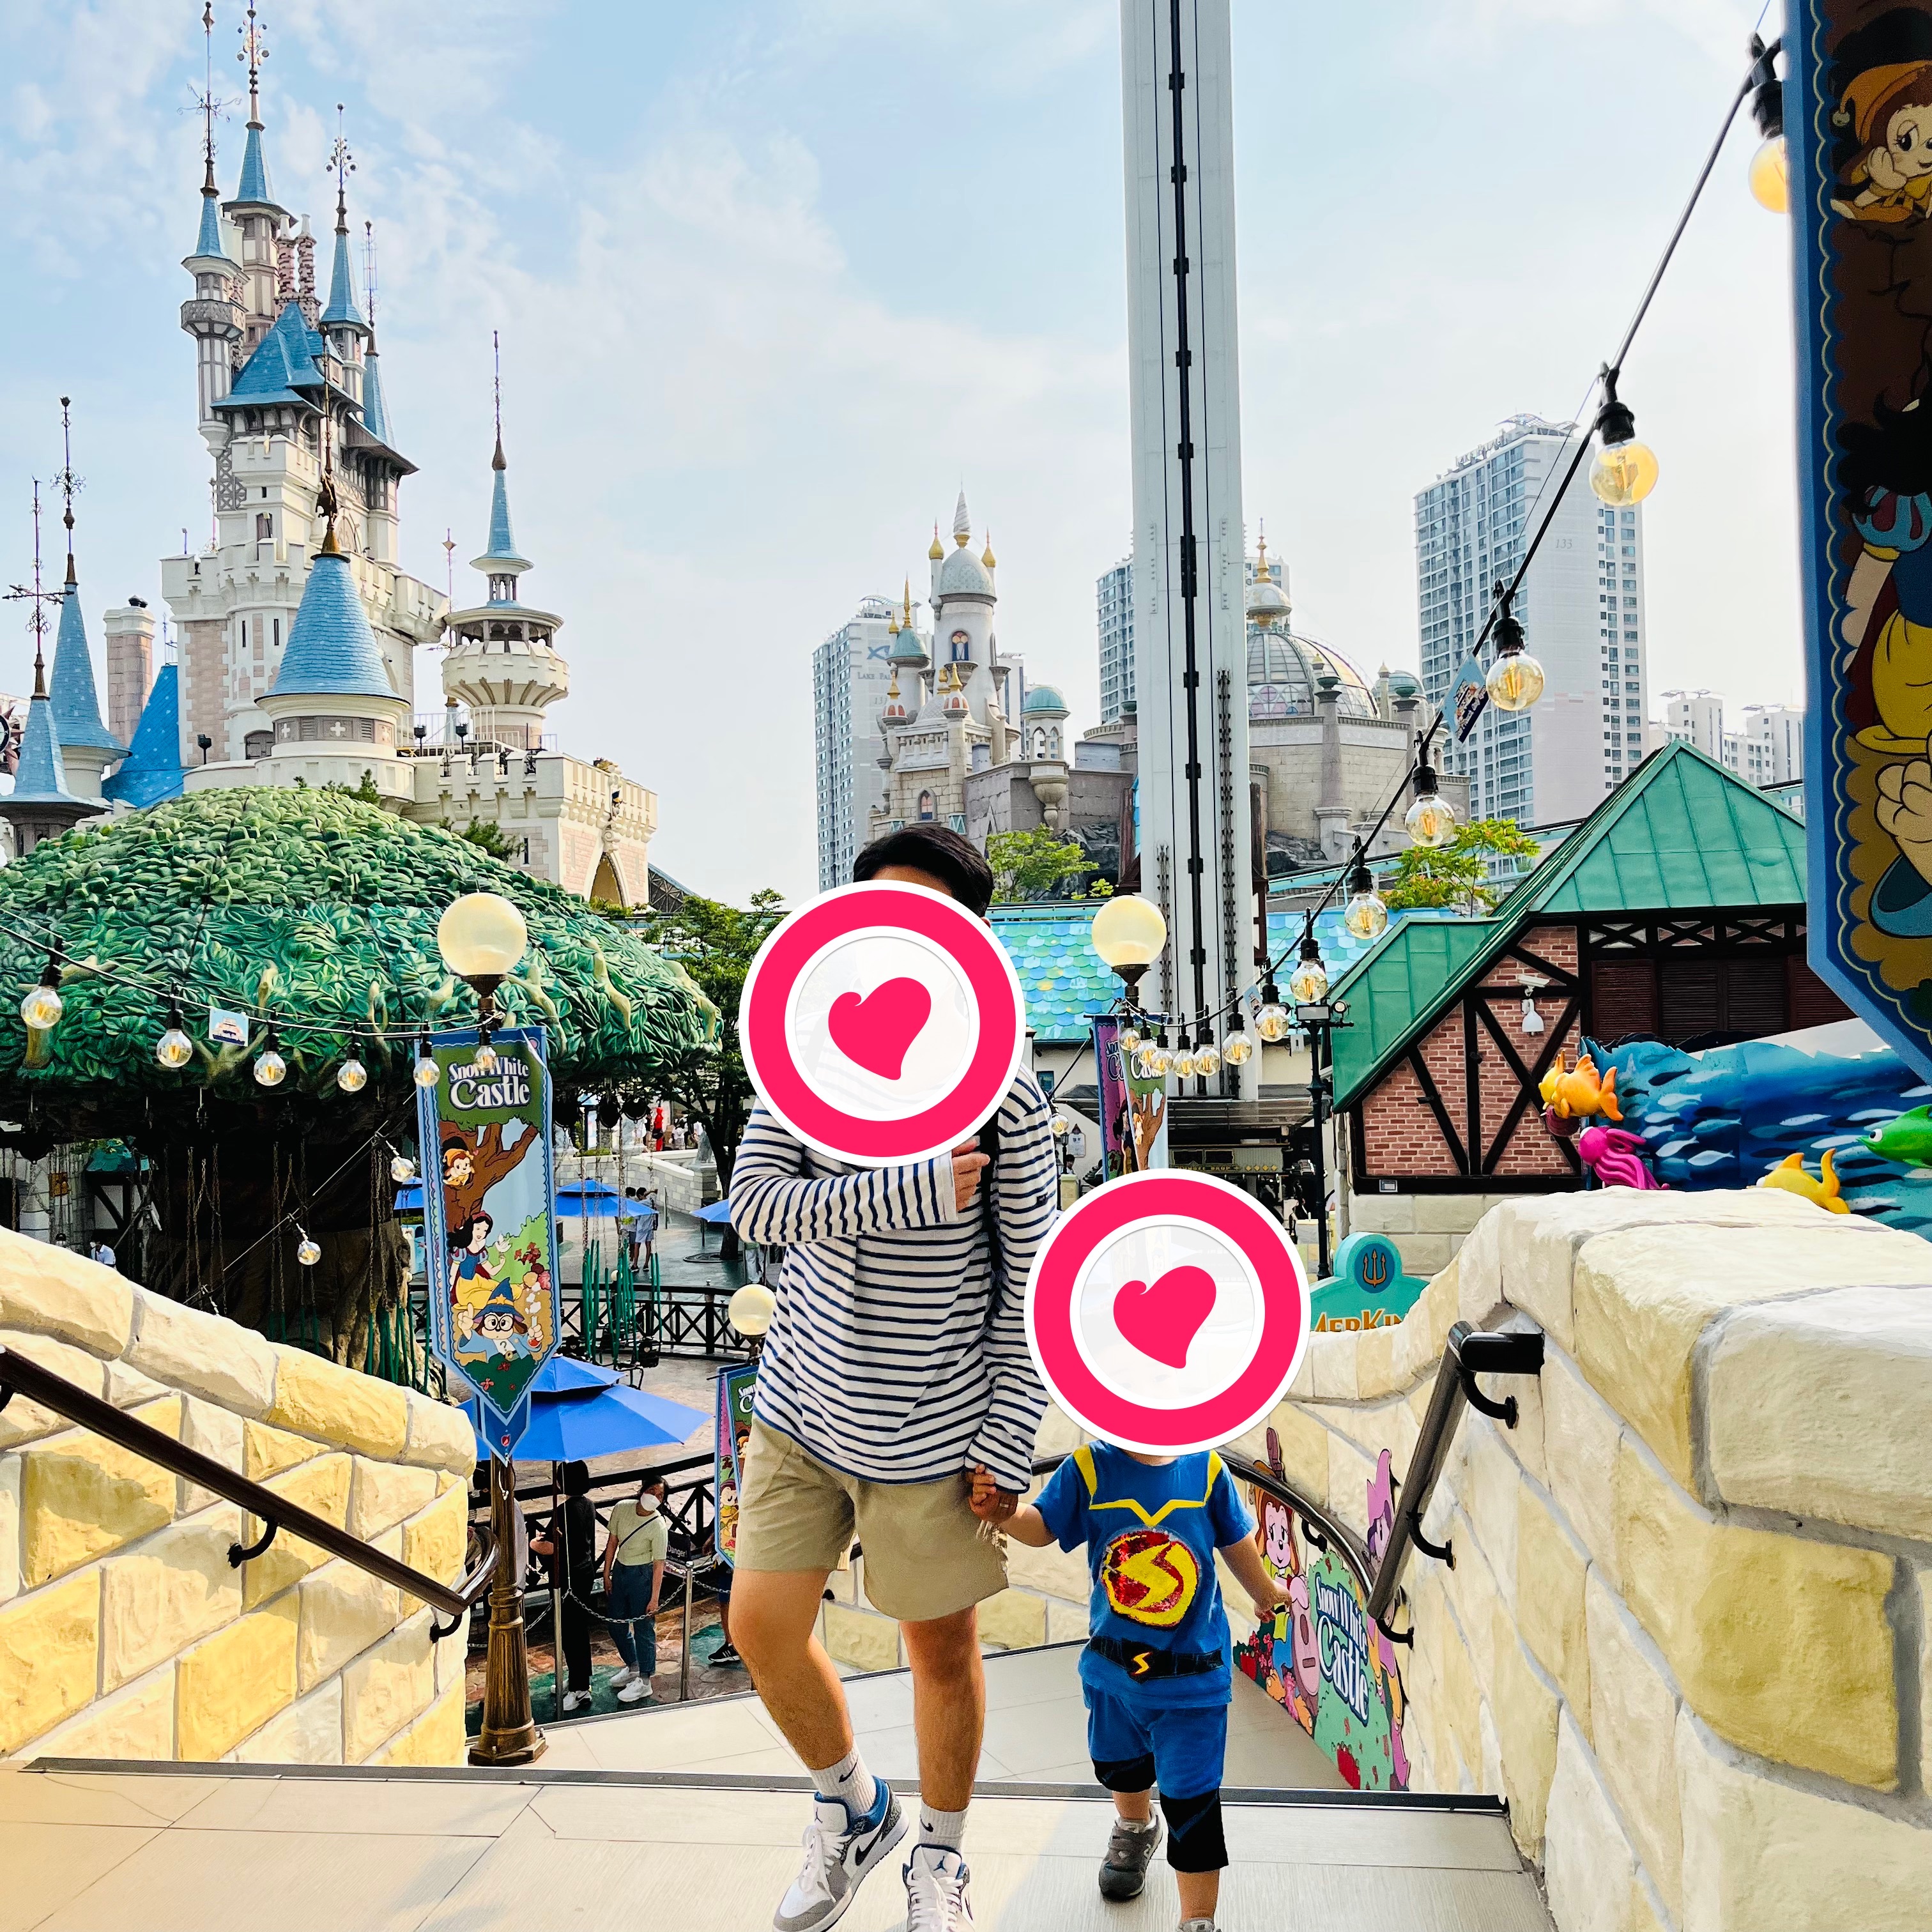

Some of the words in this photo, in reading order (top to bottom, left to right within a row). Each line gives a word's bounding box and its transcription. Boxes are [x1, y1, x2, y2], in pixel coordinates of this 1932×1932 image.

[1555, 539, 1572, 549] 133
[857, 671, 875, 680] LAKE
[879, 672, 893, 680] PAL
[450, 1075, 530, 1109] Castle
[1315, 1575, 1340, 1621] Snow
[1338, 1586, 1368, 1660] White
[1317, 1614, 1368, 1721] Castle
